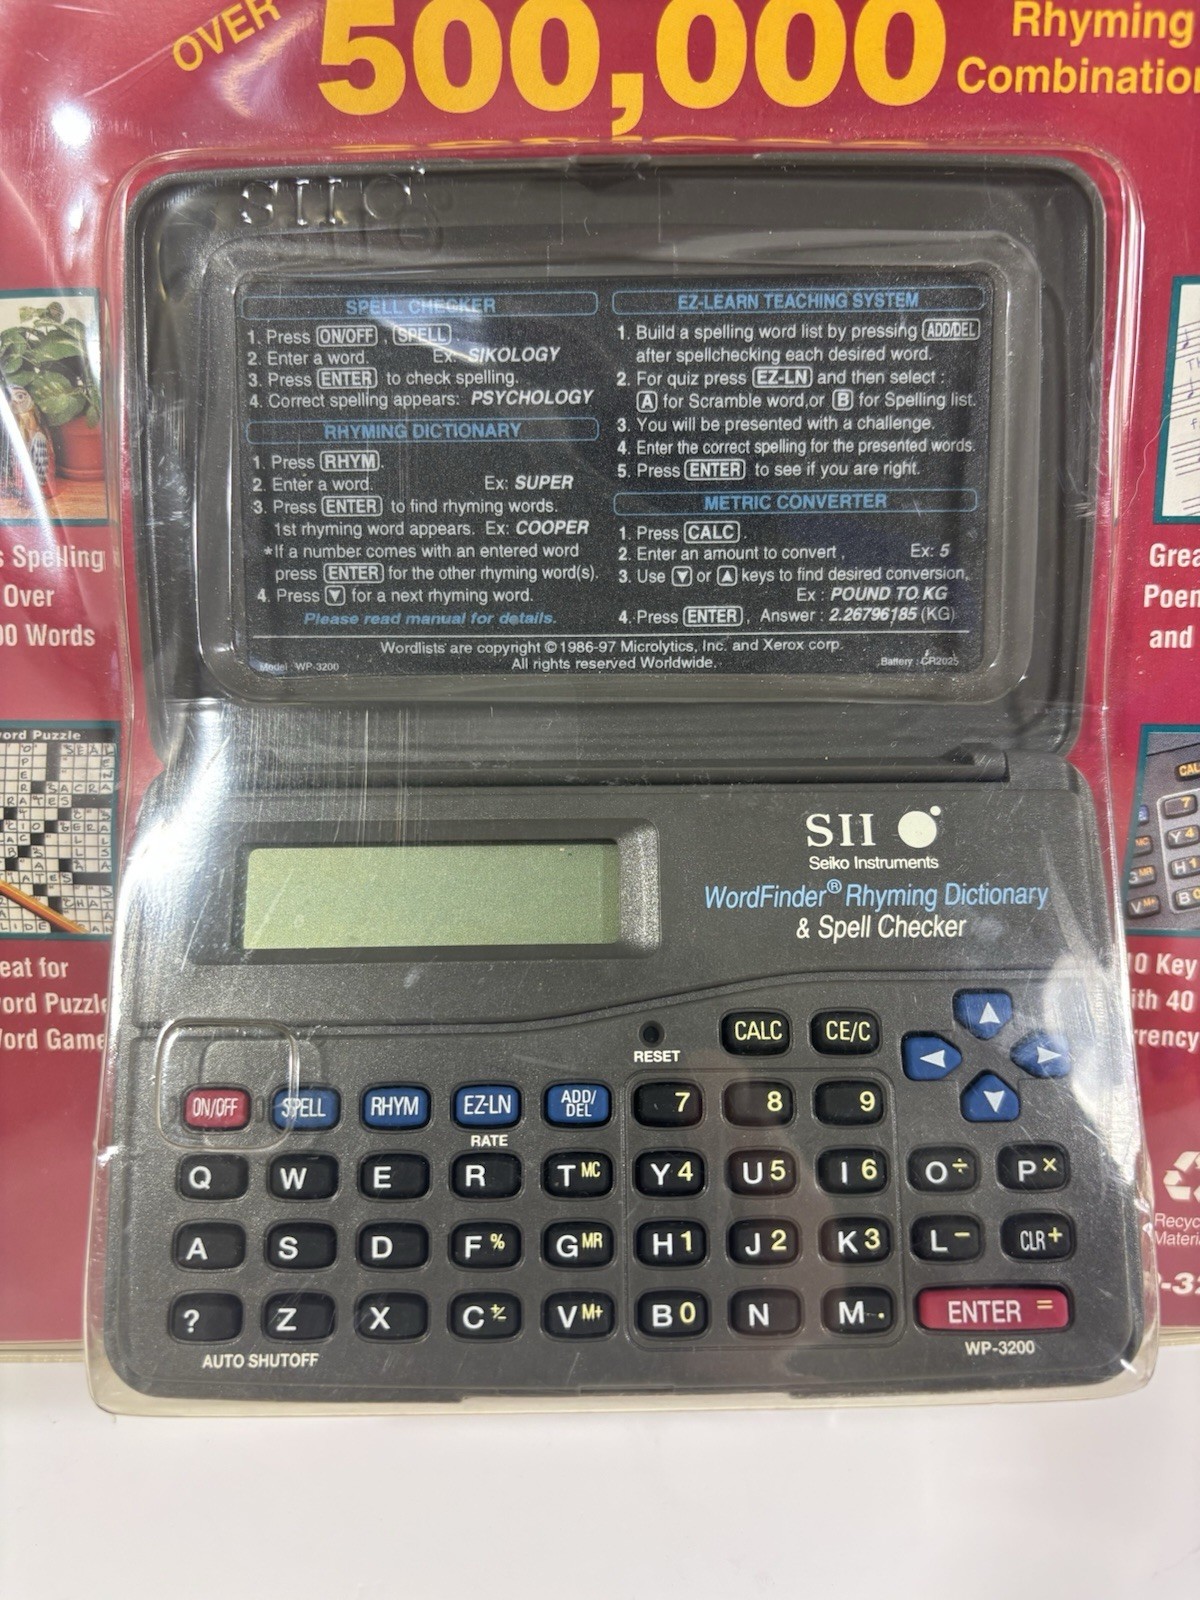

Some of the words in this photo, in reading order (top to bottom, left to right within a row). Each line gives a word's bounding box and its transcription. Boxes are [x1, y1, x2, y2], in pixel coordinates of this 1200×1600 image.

[1012, 0, 1195, 49] Rhyming
[173, 0, 281, 71] OVER
[318, 0, 946, 136] 500,000
[346, 300, 405, 315] SPELL
[408, 298, 496, 314] CHECKER
[678, 295, 758, 310] EZ-LEARN
[765, 293, 848, 309] TEACHING
[852, 292, 919, 308] SYSTEM
[617, 326, 630, 340] 1.
[637, 325, 674, 340] Build
[680, 328, 689, 340] a
[694, 324, 754, 342] spelling
[759, 324, 796, 339] word
[802, 323, 823, 339] list
[827, 324, 845, 342] by
[851, 323, 917, 342] pressing
[927, 321, 976, 337] ADD/DEL
[248, 352, 262, 366] 2.
[267, 351, 308, 366] Enter
[313, 354, 323, 365] a
[327, 350, 369, 365] word.
[468, 346, 561, 364] SIKOLOGY
[637, 348, 671, 363] after
[676, 347, 780, 366] spellchecking
[785, 346, 824, 362] each
[829, 346, 885, 362] desired
[891, 346, 932, 362] word.
[248, 374, 262, 388] 3.
[268, 373, 312, 387] Press
[321, 372, 373, 386] ENTER
[387, 372, 401, 385] to
[406, 370, 451, 385] check
[456, 369, 519, 389] spelling.
[249, 395, 263, 408] 4.
[268, 394, 325, 408] Correct
[330, 393, 389, 410] spelling
[393, 394, 460, 409] appears:
[471, 390, 594, 406] PSYCHOLOGY
[324, 424, 407, 440] RHYMING
[413, 423, 522, 439] DICTIONARY
[617, 441, 631, 456] 4.
[637, 441, 673, 456] Enter
[678, 440, 698, 455] the
[703, 440, 751, 454] correct
[754, 438, 806, 457] spelling
[810, 438, 829, 454] for
[833, 438, 854, 453] the
[859, 438, 927, 456] presented
[931, 437, 976, 452] words.
[618, 463, 631, 478] 5.
[637, 463, 680, 478] Press
[690, 462, 740, 477] ENTER
[755, 463, 769, 477] to
[774, 465, 802, 477] see
[806, 461, 815, 476] if
[820, 465, 848, 480] you
[854, 464, 878, 476] are
[883, 460, 920, 479] right.
[253, 500, 267, 515] 3.
[274, 500, 316, 514] Press
[325, 499, 377, 514] ENTER
[391, 500, 405, 513] to
[410, 499, 438, 513] find
[443, 499, 503, 517] rhyming
[508, 498, 558, 513] words.
[704, 495, 772, 510] METRIC
[777, 493, 887, 510] CONVERTER
[274, 522, 297, 536] 1st
[302, 522, 362, 539] rhyming
[367, 521, 405, 536] word
[410, 523, 475, 539] appears.
[486, 522, 510, 535] Ex:
[516, 520, 590, 535] COOPER
[13, 545, 105, 573] Spelling
[4, 584, 55, 607] Over
[304, 612, 359, 626] Please
[364, 612, 400, 625] read
[406, 612, 466, 626] manual
[471, 612, 495, 625] for
[499, 611, 557, 625] details.
[26, 624, 96, 646] Words
[1150, 625, 1193, 648] and
[380, 641, 447, 655] Wordlists
[450, 643, 473, 655] are
[477, 641, 540, 657] copyright
[620, 639, 698, 654] Microlytics,
[702, 639, 727, 652] Inc.
[732, 638, 759, 652] and
[763, 637, 804, 652] Xerox
[295, 662, 339, 672] WP-3200
[511, 657, 528, 670] All
[533, 657, 570, 672] rights
[575, 657, 636, 670] reserved
[641, 656, 717, 669] Worldwide.
[880, 657, 913, 667] Battery
[33, 730, 81, 741] Puzzle
[805, 813, 877, 848] SII
[809, 856, 850, 870] Seiko
[854, 855, 939, 870] Instruments
[846, 883, 938, 912] Rhyming
[944, 882, 1049, 911] Dictionary
[796, 917, 811, 940] &
[818, 915, 871, 944] Spell
[878, 913, 967, 939] Checker
[39, 957, 68, 977] for
[1156, 953, 1197, 980] Key
[1166, 990, 1194, 1012] 40
[734, 1020, 782, 1041] CALC
[825, 1020, 871, 1043] CE/C
[634, 1050, 680, 1063] RESET
[191, 1096, 239, 1118] ON/OFF
[370, 1096, 419, 1117] RHYM
[463, 1094, 512, 1115] EZ-LN
[560, 1088, 596, 1106] ADD/
[674, 1091, 691, 1113] 7
[766, 1090, 784, 1113] 8
[859, 1090, 876, 1113] 9
[281, 1097, 326, 1118] SPELL
[565, 1103, 593, 1118] DEL
[470, 1134, 509, 1148] RATE
[188, 1166, 212, 1190] Q
[464, 1164, 486, 1187] R
[557, 1164, 575, 1187] T
[581, 1160, 601, 1178] MC
[948, 1299, 1022, 1324] ENTER
[965, 1339, 1036, 1356] WP-3200
[202, 1354, 245, 1370] AUTO
[248, 1352, 320, 1369] SHUTOFF
